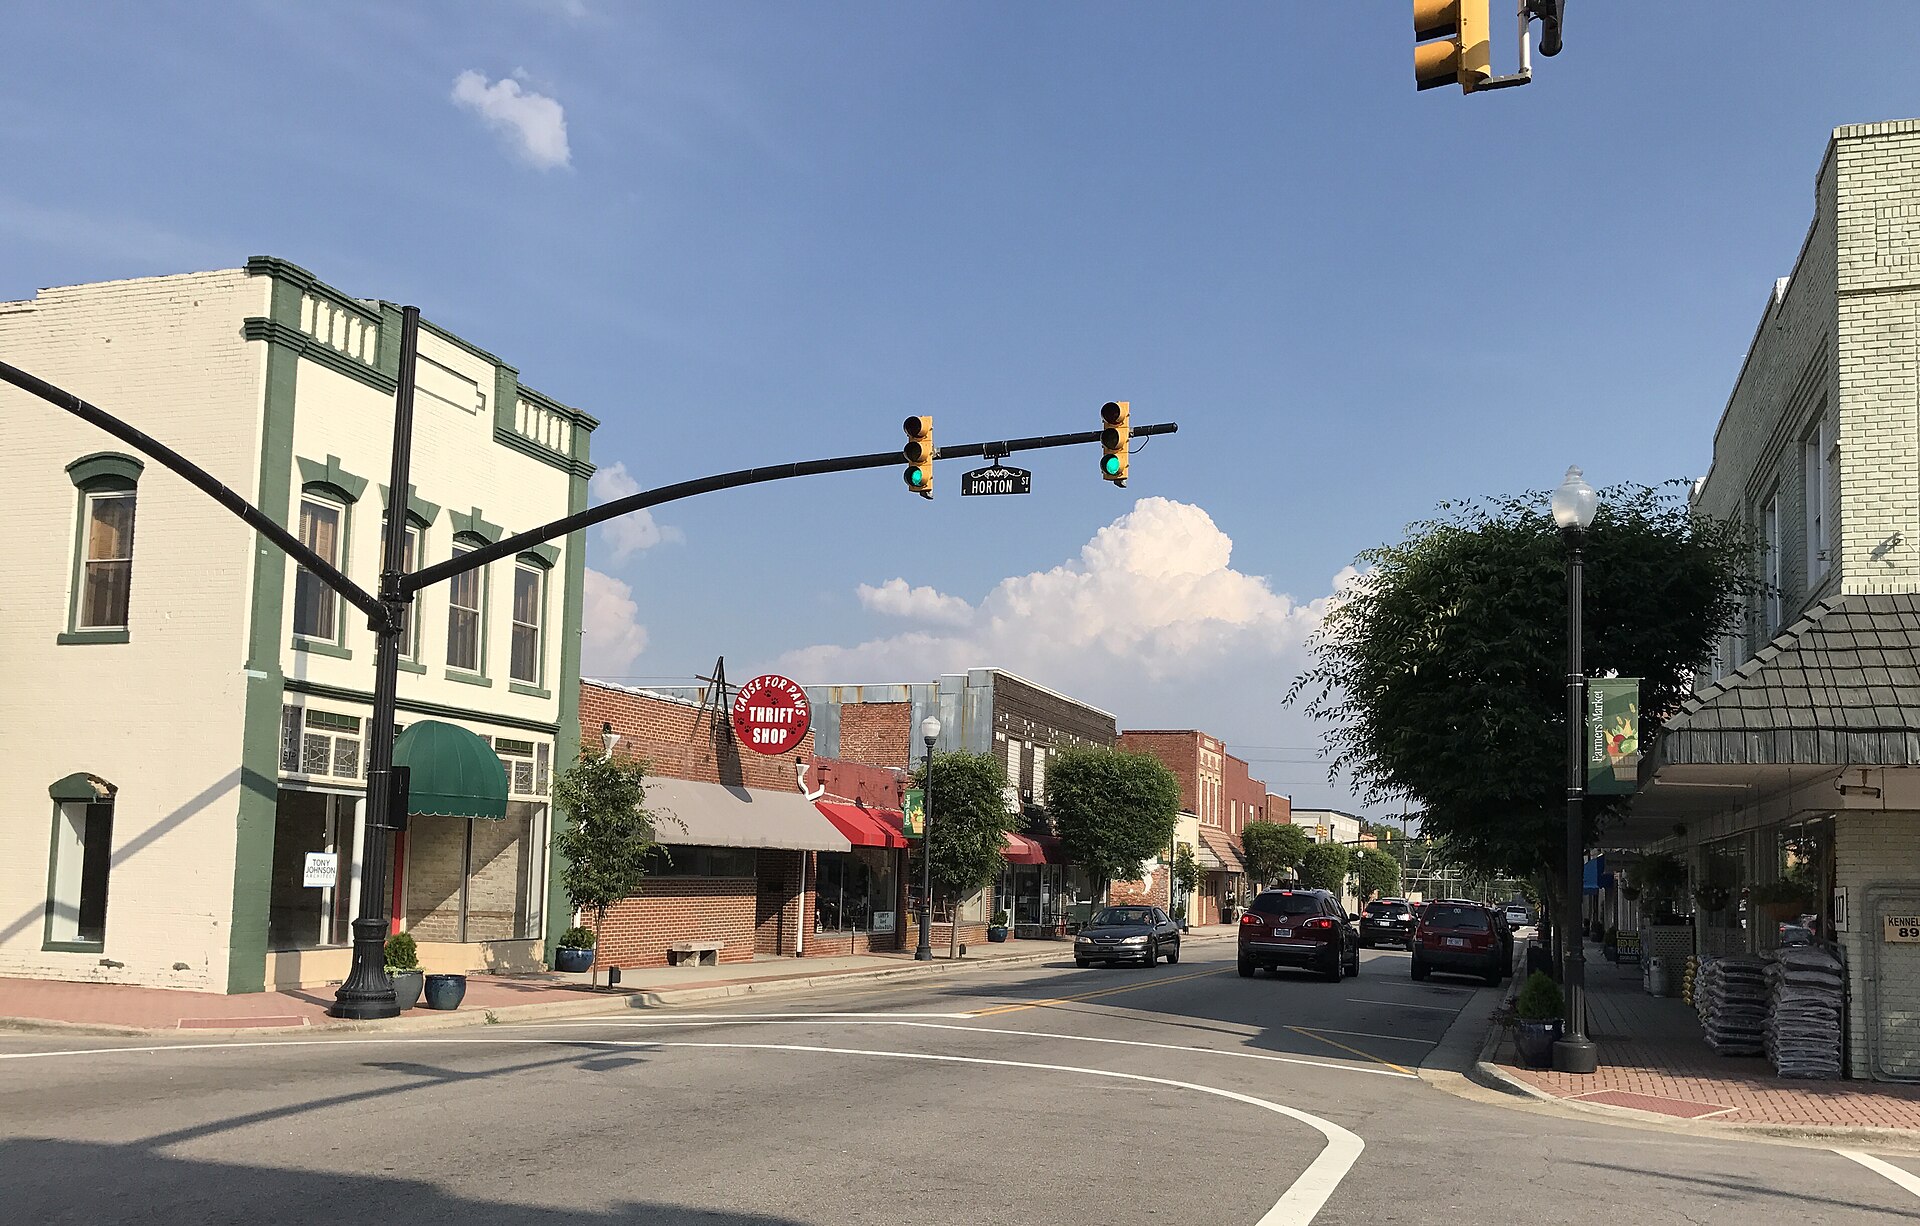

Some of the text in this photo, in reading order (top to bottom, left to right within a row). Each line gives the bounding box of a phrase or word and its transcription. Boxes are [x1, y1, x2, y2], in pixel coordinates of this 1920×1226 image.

[972, 476, 1029, 494] HORTON ST
[735, 676, 806, 716] CAUSE FOR PAWS
[749, 706, 794, 724] THRIFT
[1592, 690, 1603, 762] Farmers Market
[752, 728, 787, 744] SHOP
